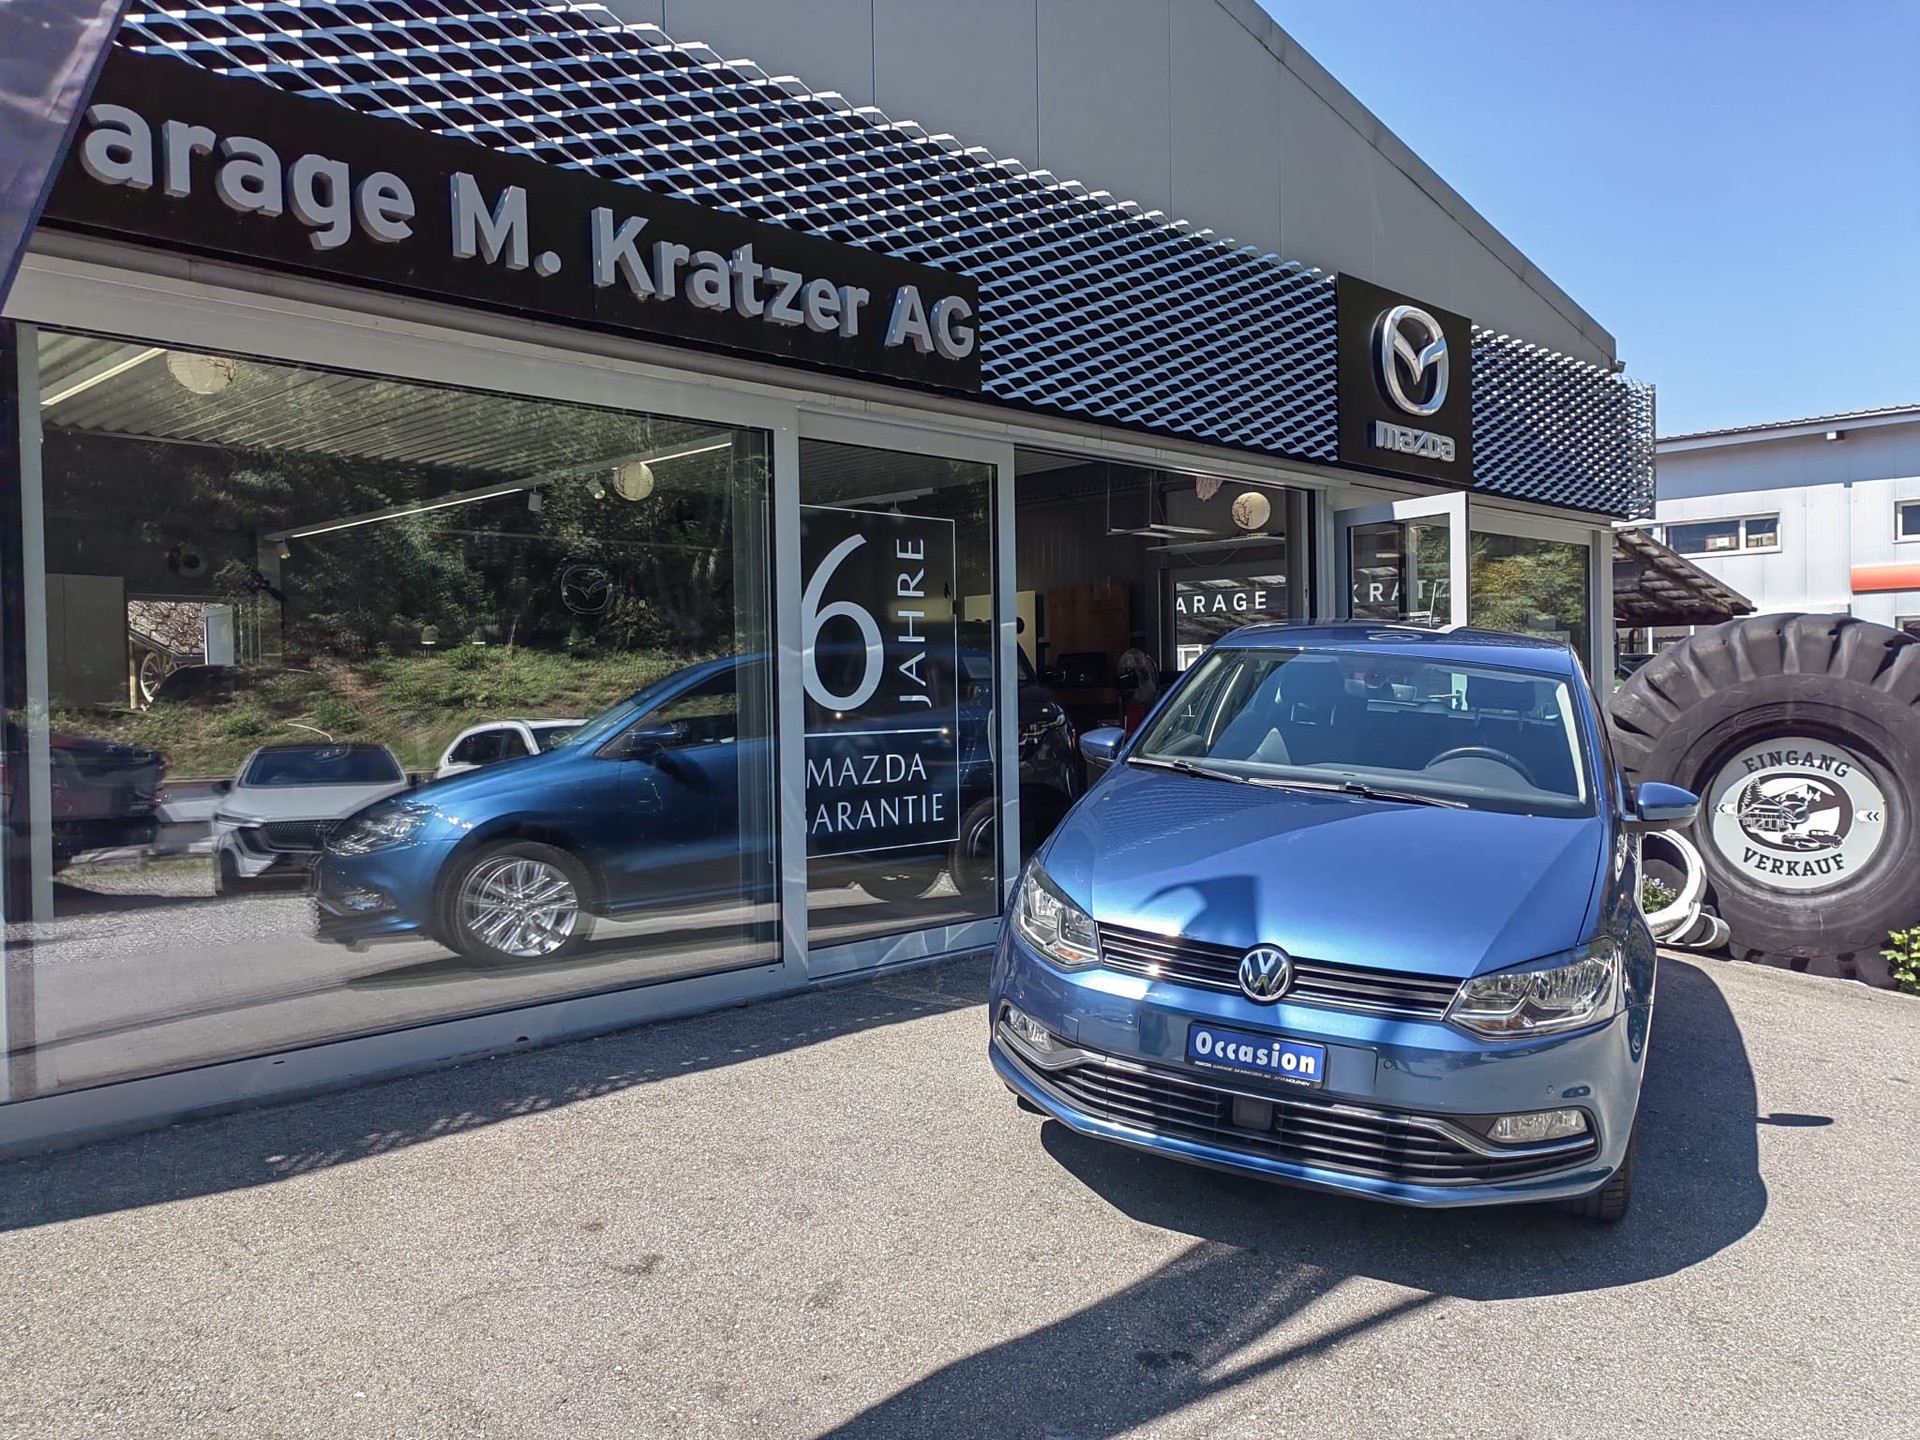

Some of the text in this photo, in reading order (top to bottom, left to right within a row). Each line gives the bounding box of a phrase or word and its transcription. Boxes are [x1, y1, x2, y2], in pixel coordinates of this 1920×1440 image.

[80, 103, 975, 360] arage M. Kratzer AG
[801, 533, 884, 711] 6
[1176, 590, 1267, 614] ARAGE
[896, 538, 932, 709] JAHRE
[806, 753, 927, 789] MAZDA
[1742, 750, 1851, 778] EINGANG
[812, 793, 945, 834] ARANTIE
[1743, 847, 1845, 876] VERKAUF
[1195, 1031, 1315, 1075] Occasion
